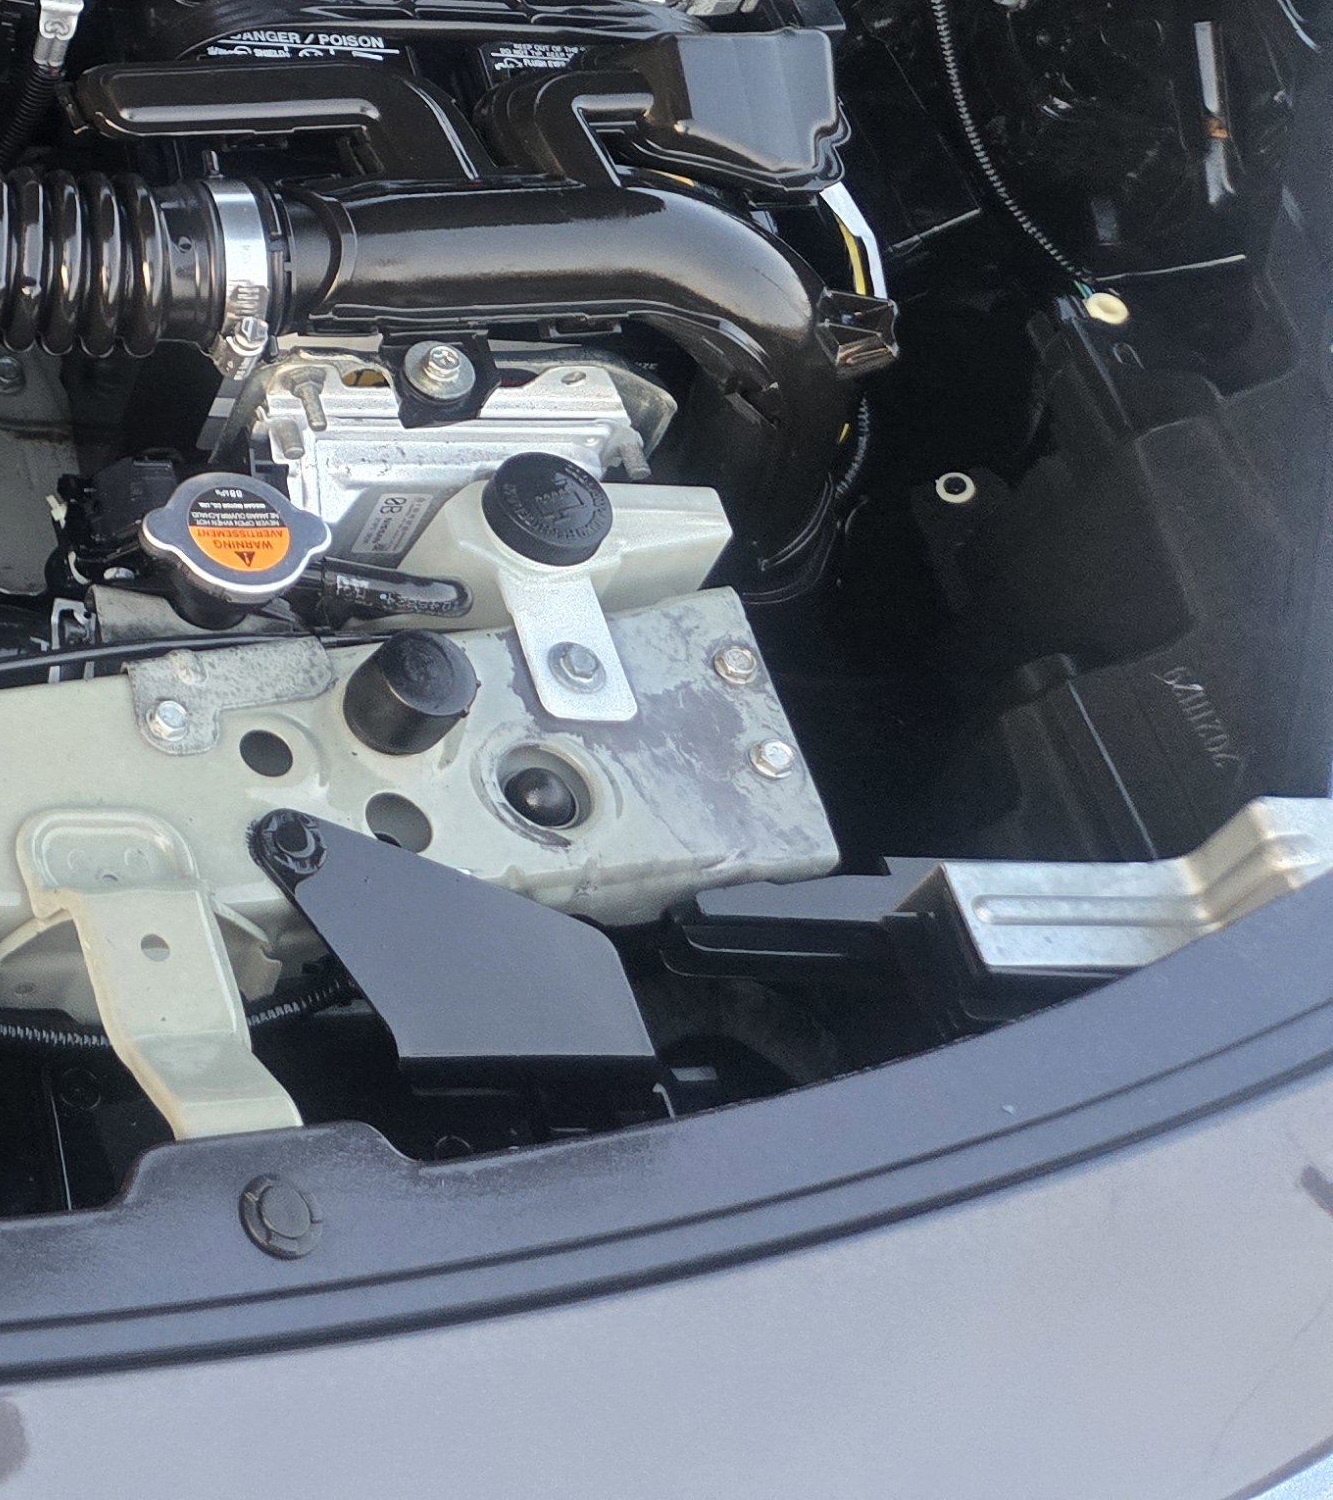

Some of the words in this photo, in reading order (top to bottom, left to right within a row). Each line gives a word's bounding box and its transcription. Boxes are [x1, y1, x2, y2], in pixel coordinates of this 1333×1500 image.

[319, 34, 384, 48] POISON
[197, 529, 283, 538] AVERTISSEMENT
[213, 540, 273, 550] WARNING
